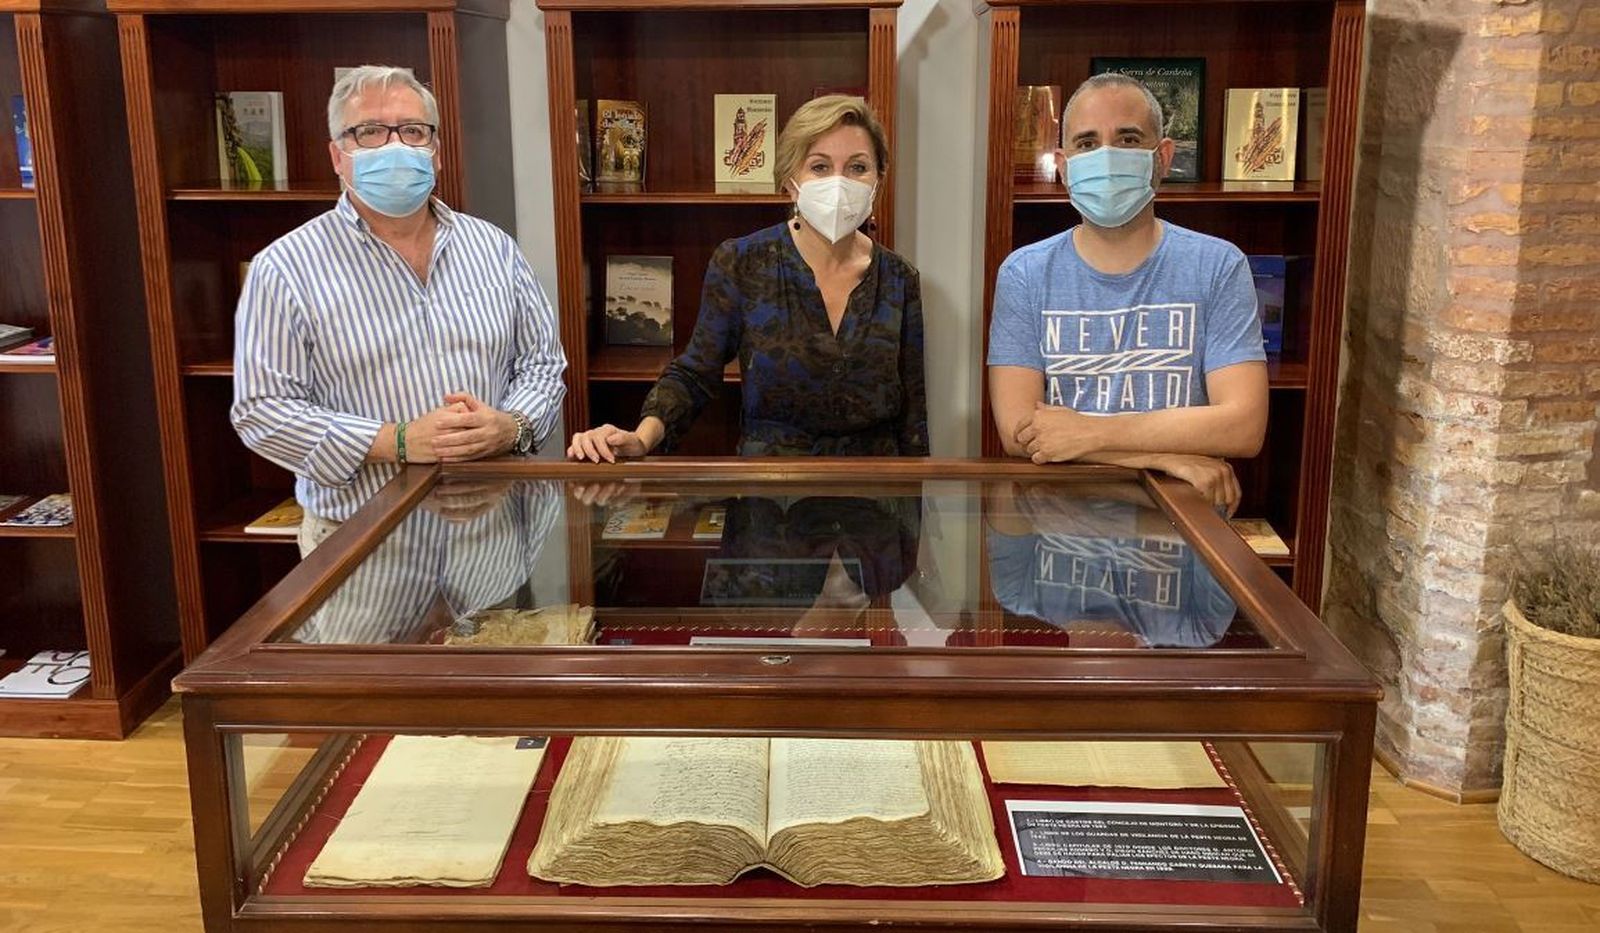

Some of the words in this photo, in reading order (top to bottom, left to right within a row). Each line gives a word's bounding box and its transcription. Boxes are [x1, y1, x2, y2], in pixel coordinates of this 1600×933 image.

[1146, 67, 1156, 76] de
[1046, 310, 1184, 352] NEVER
[1050, 372, 1182, 411] AFRAID
